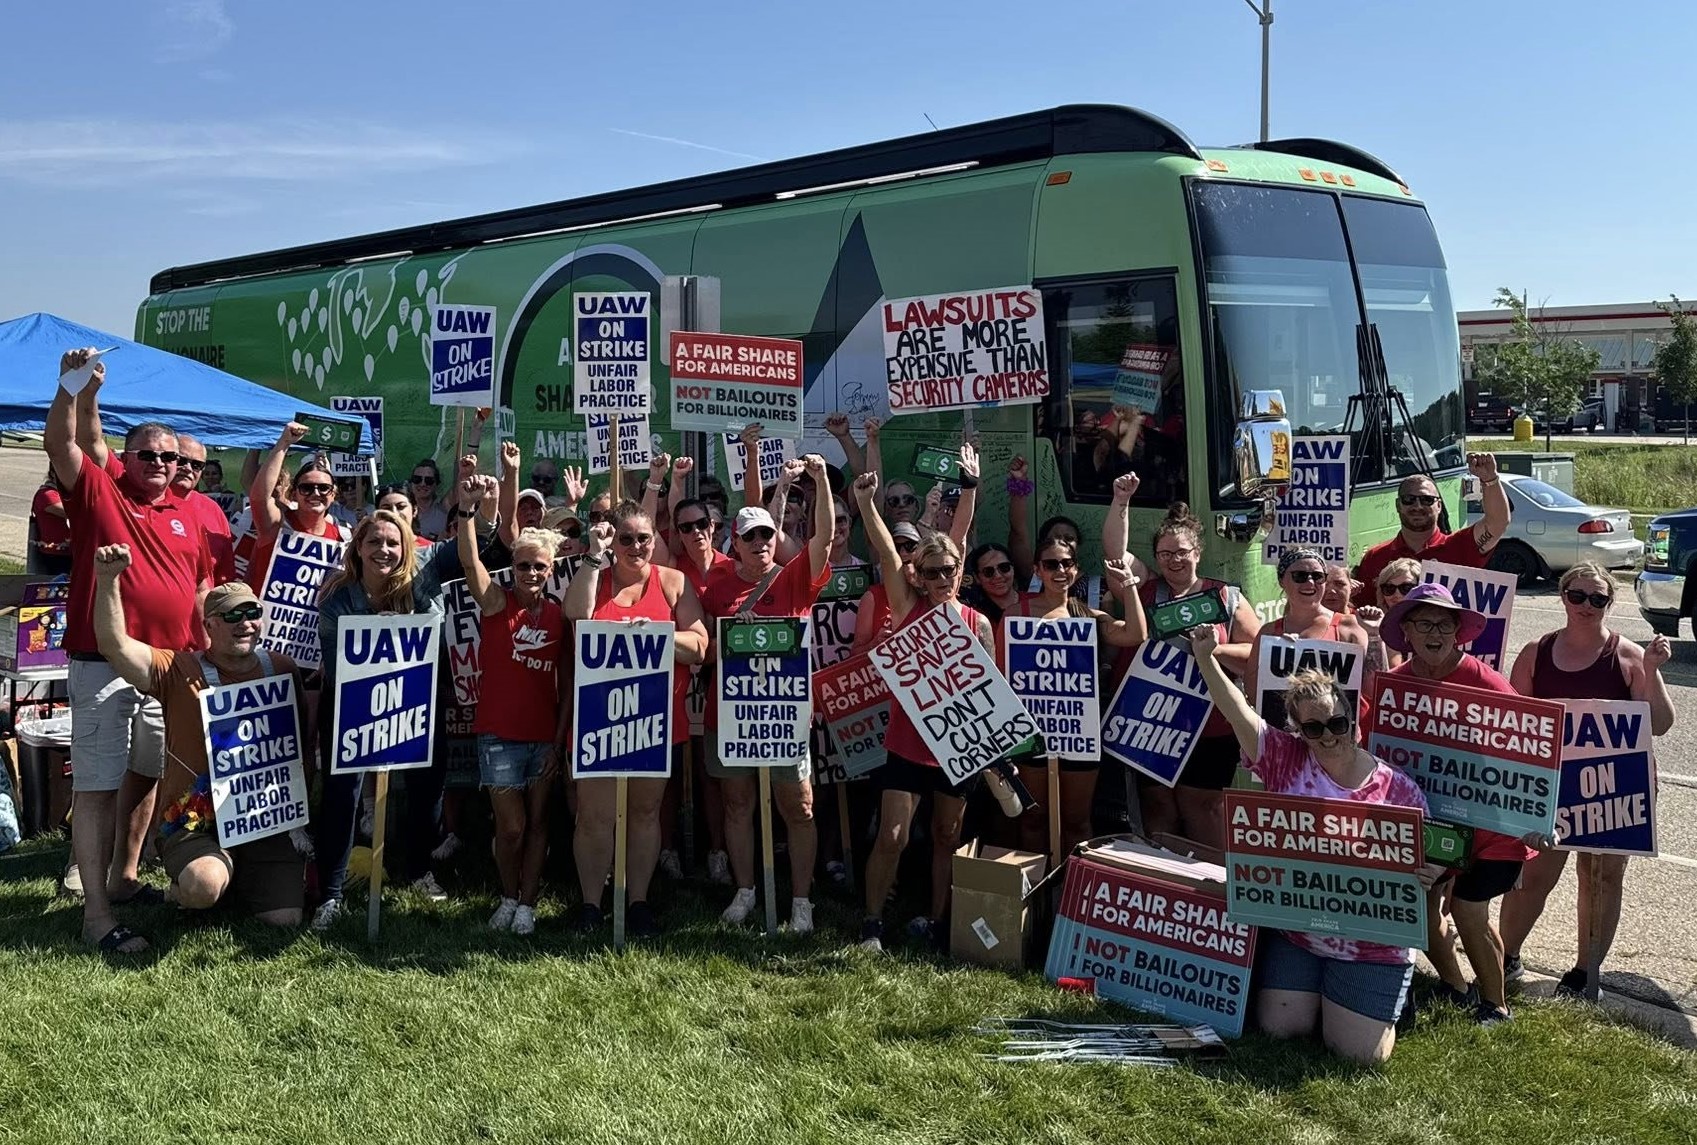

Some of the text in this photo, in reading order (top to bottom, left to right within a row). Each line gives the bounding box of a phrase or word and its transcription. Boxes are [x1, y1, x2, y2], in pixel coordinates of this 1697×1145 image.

[578, 296, 647, 314] UAW
[884, 291, 1037, 332] LAWSUITS
[155, 306, 211, 335] STOP THE
[437, 308, 492, 335] UAW
[598, 320, 625, 338] ON
[449, 341, 473, 364] ON
[580, 340, 645, 358] STRIKE
[897, 319, 1031, 358] ARE MORE
[675, 342, 796, 366] A FAIR SHARE
[886, 340, 1044, 384] EXPENSIVE THAN
[432, 357, 492, 393] STRIKE
[587, 363, 638, 378] UNFAIR
[676, 360, 796, 380] FOR AMERICANS
[590, 378, 636, 393] LABOR
[676, 385, 797, 408] NOT BAILOUTS
[889, 369, 1050, 408] SECURITY CAMERAS
[333, 399, 382, 411] UAW
[579, 394, 647, 408] PRACTICE
[676, 402, 797, 422] FOR BILLIONAIRES
[597, 425, 639, 441] UNAIR
[600, 438, 638, 454] LAOR
[741, 452, 784, 471] LBOR
[1292, 440, 1345, 460] AW
[336, 463, 382, 473] PRACTIE
[1278, 513, 1334, 528] UNFAIR
[1280, 530, 1331, 544] LABOR
[296, 565, 325, 587] ON
[268, 580, 319, 608] STRI
[268, 623, 317, 646] LABOR
[343, 627, 433, 665] UAW
[876, 601, 954, 670] SECURITY
[1009, 620, 1093, 643] UAW
[527, 657, 542, 670] DO
[580, 633, 668, 669] UAW
[894, 624, 972, 688] SAVES
[1035, 648, 1067, 669] ON
[1270, 645, 1357, 685] UAW
[370, 675, 404, 717] ON
[725, 675, 806, 697] STRIKE
[821, 682, 837, 701] A
[910, 653, 986, 713] LIVES
[1012, 670, 1093, 693] STRIKE
[206, 679, 289, 716] UAW
[607, 682, 640, 722] ON
[826, 692, 860, 715] FOR
[922, 678, 996, 742] DON'T
[1142, 691, 1182, 723] ON
[734, 704, 798, 721] UNFAIR
[1032, 714, 1082, 735] ABOR
[1379, 687, 1555, 739] A FAIR SHARE
[238, 715, 270, 741] ON
[341, 703, 428, 763] STRIKE
[580, 712, 664, 766] STRIKE
[738, 723, 795, 740] LABOR
[837, 716, 875, 743] NOT
[950, 709, 994, 755] CUT
[1103, 714, 1191, 758] STRIKE
[1379, 709, 1553, 759] FOR AMERICANS
[216, 735, 296, 772] STRIKE
[724, 741, 806, 759] PRACTICE
[844, 737, 875, 758] FOR
[947, 712, 1036, 779] CORNERS
[229, 765, 290, 795] UNFAIR
[1376, 742, 1549, 798] NOT BAILOUTS
[1580, 762, 1616, 799] ON
[235, 784, 290, 815] LABOR
[224, 801, 305, 840] PRACTICE
[1232, 805, 1415, 845] A FAIR SHARE
[1556, 793, 1648, 840] STRIKE
[1234, 828, 1415, 865] FOR AMERICANS
[1234, 862, 1418, 904] NOT BAILOUTS
[1095, 882, 1249, 938] A FAIR SHARE
[1235, 886, 1418, 923] FOR BILLIONAIRES
[1092, 904, 1246, 958] FOR AMERICANS
[1085, 937, 1241, 996] NOT BAILOUTS
[1082, 959, 1116, 983] FOR
[1119, 970, 1237, 1016] BILLIONAIRES
